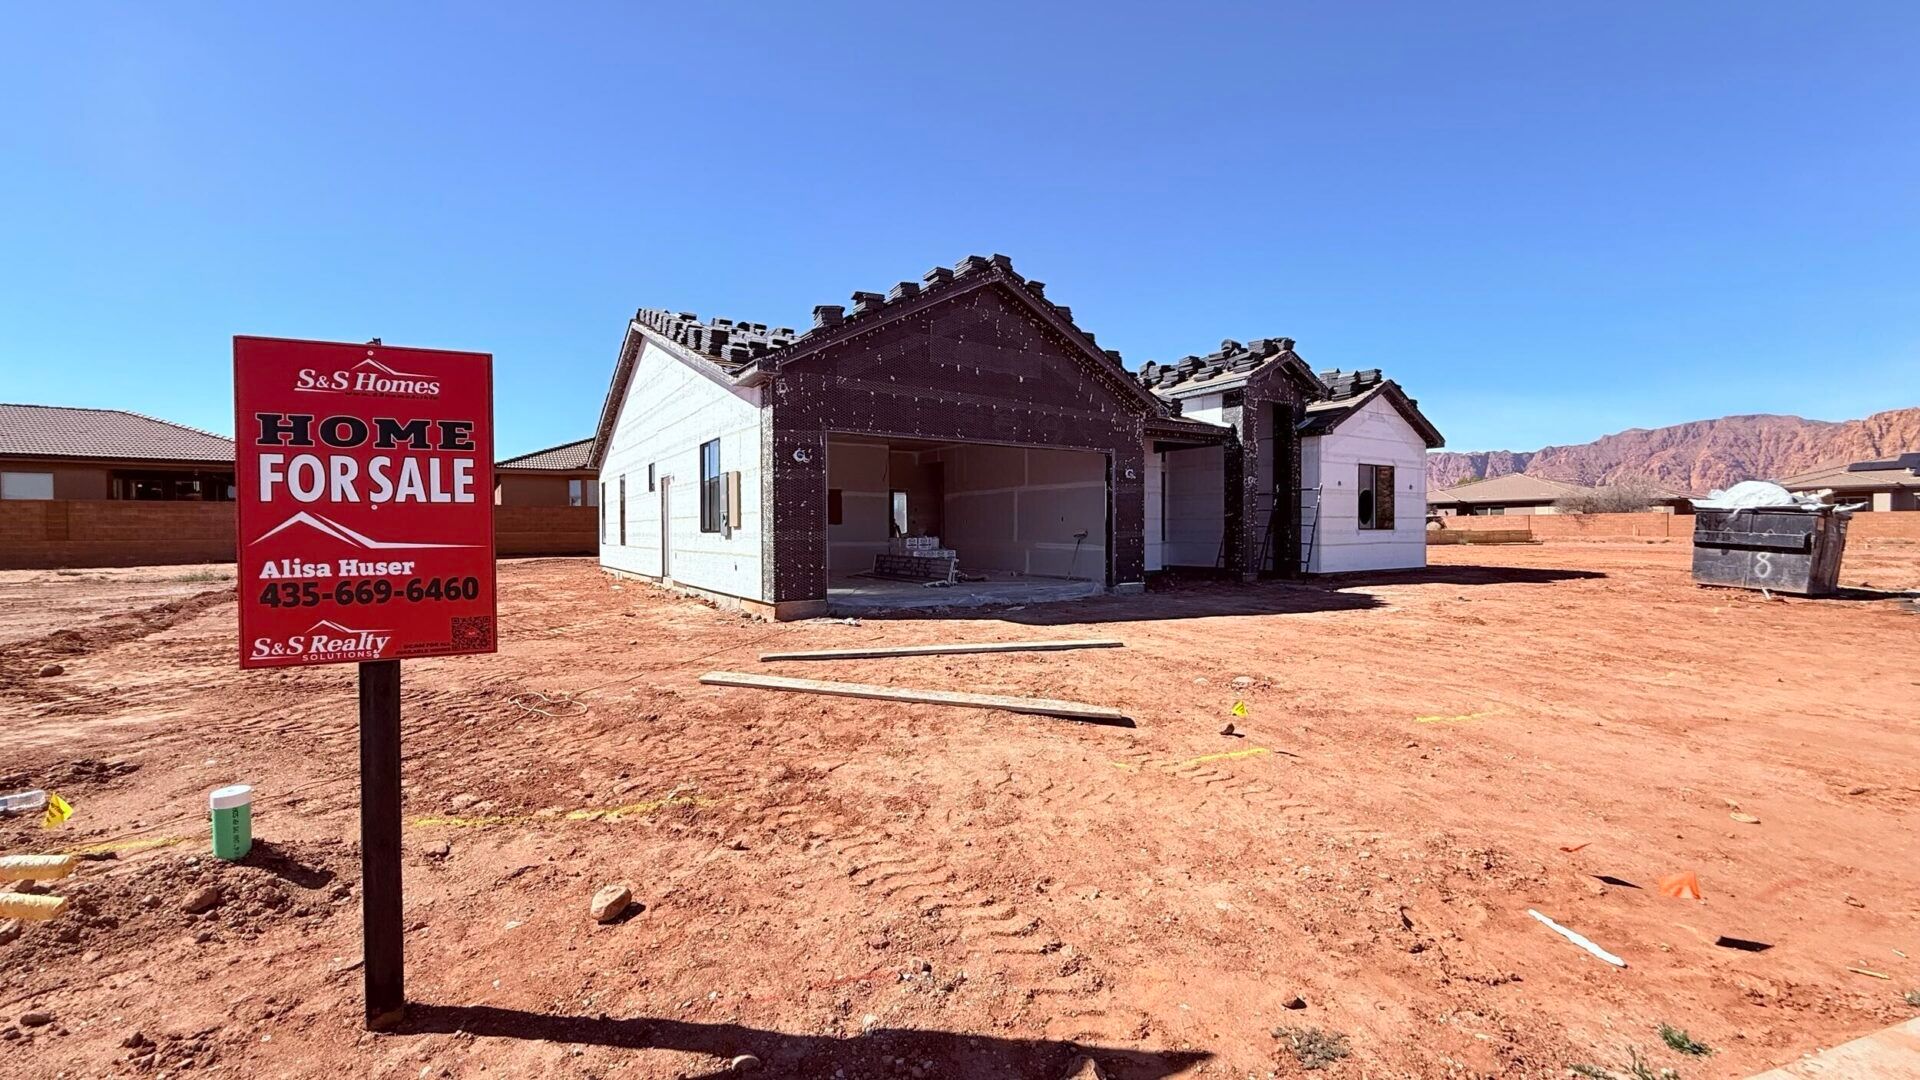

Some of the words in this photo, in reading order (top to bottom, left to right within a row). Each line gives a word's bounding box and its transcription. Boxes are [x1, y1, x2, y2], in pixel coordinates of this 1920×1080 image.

[297, 368, 350, 391] S&S
[354, 372, 440, 395] Homes
[256, 412, 476, 451] HOME
[259, 453, 361, 503] FOR
[368, 455, 476, 504] SALE
[259, 559, 332, 580] Alisa
[337, 558, 415, 578] Huser
[1754, 552, 1772, 578] 8
[259, 576, 479, 608] 435-669-6460
[252, 636, 305, 658] S&S
[310, 631, 392, 653] Realty
[302, 650, 373, 662] SOLUTIONS
